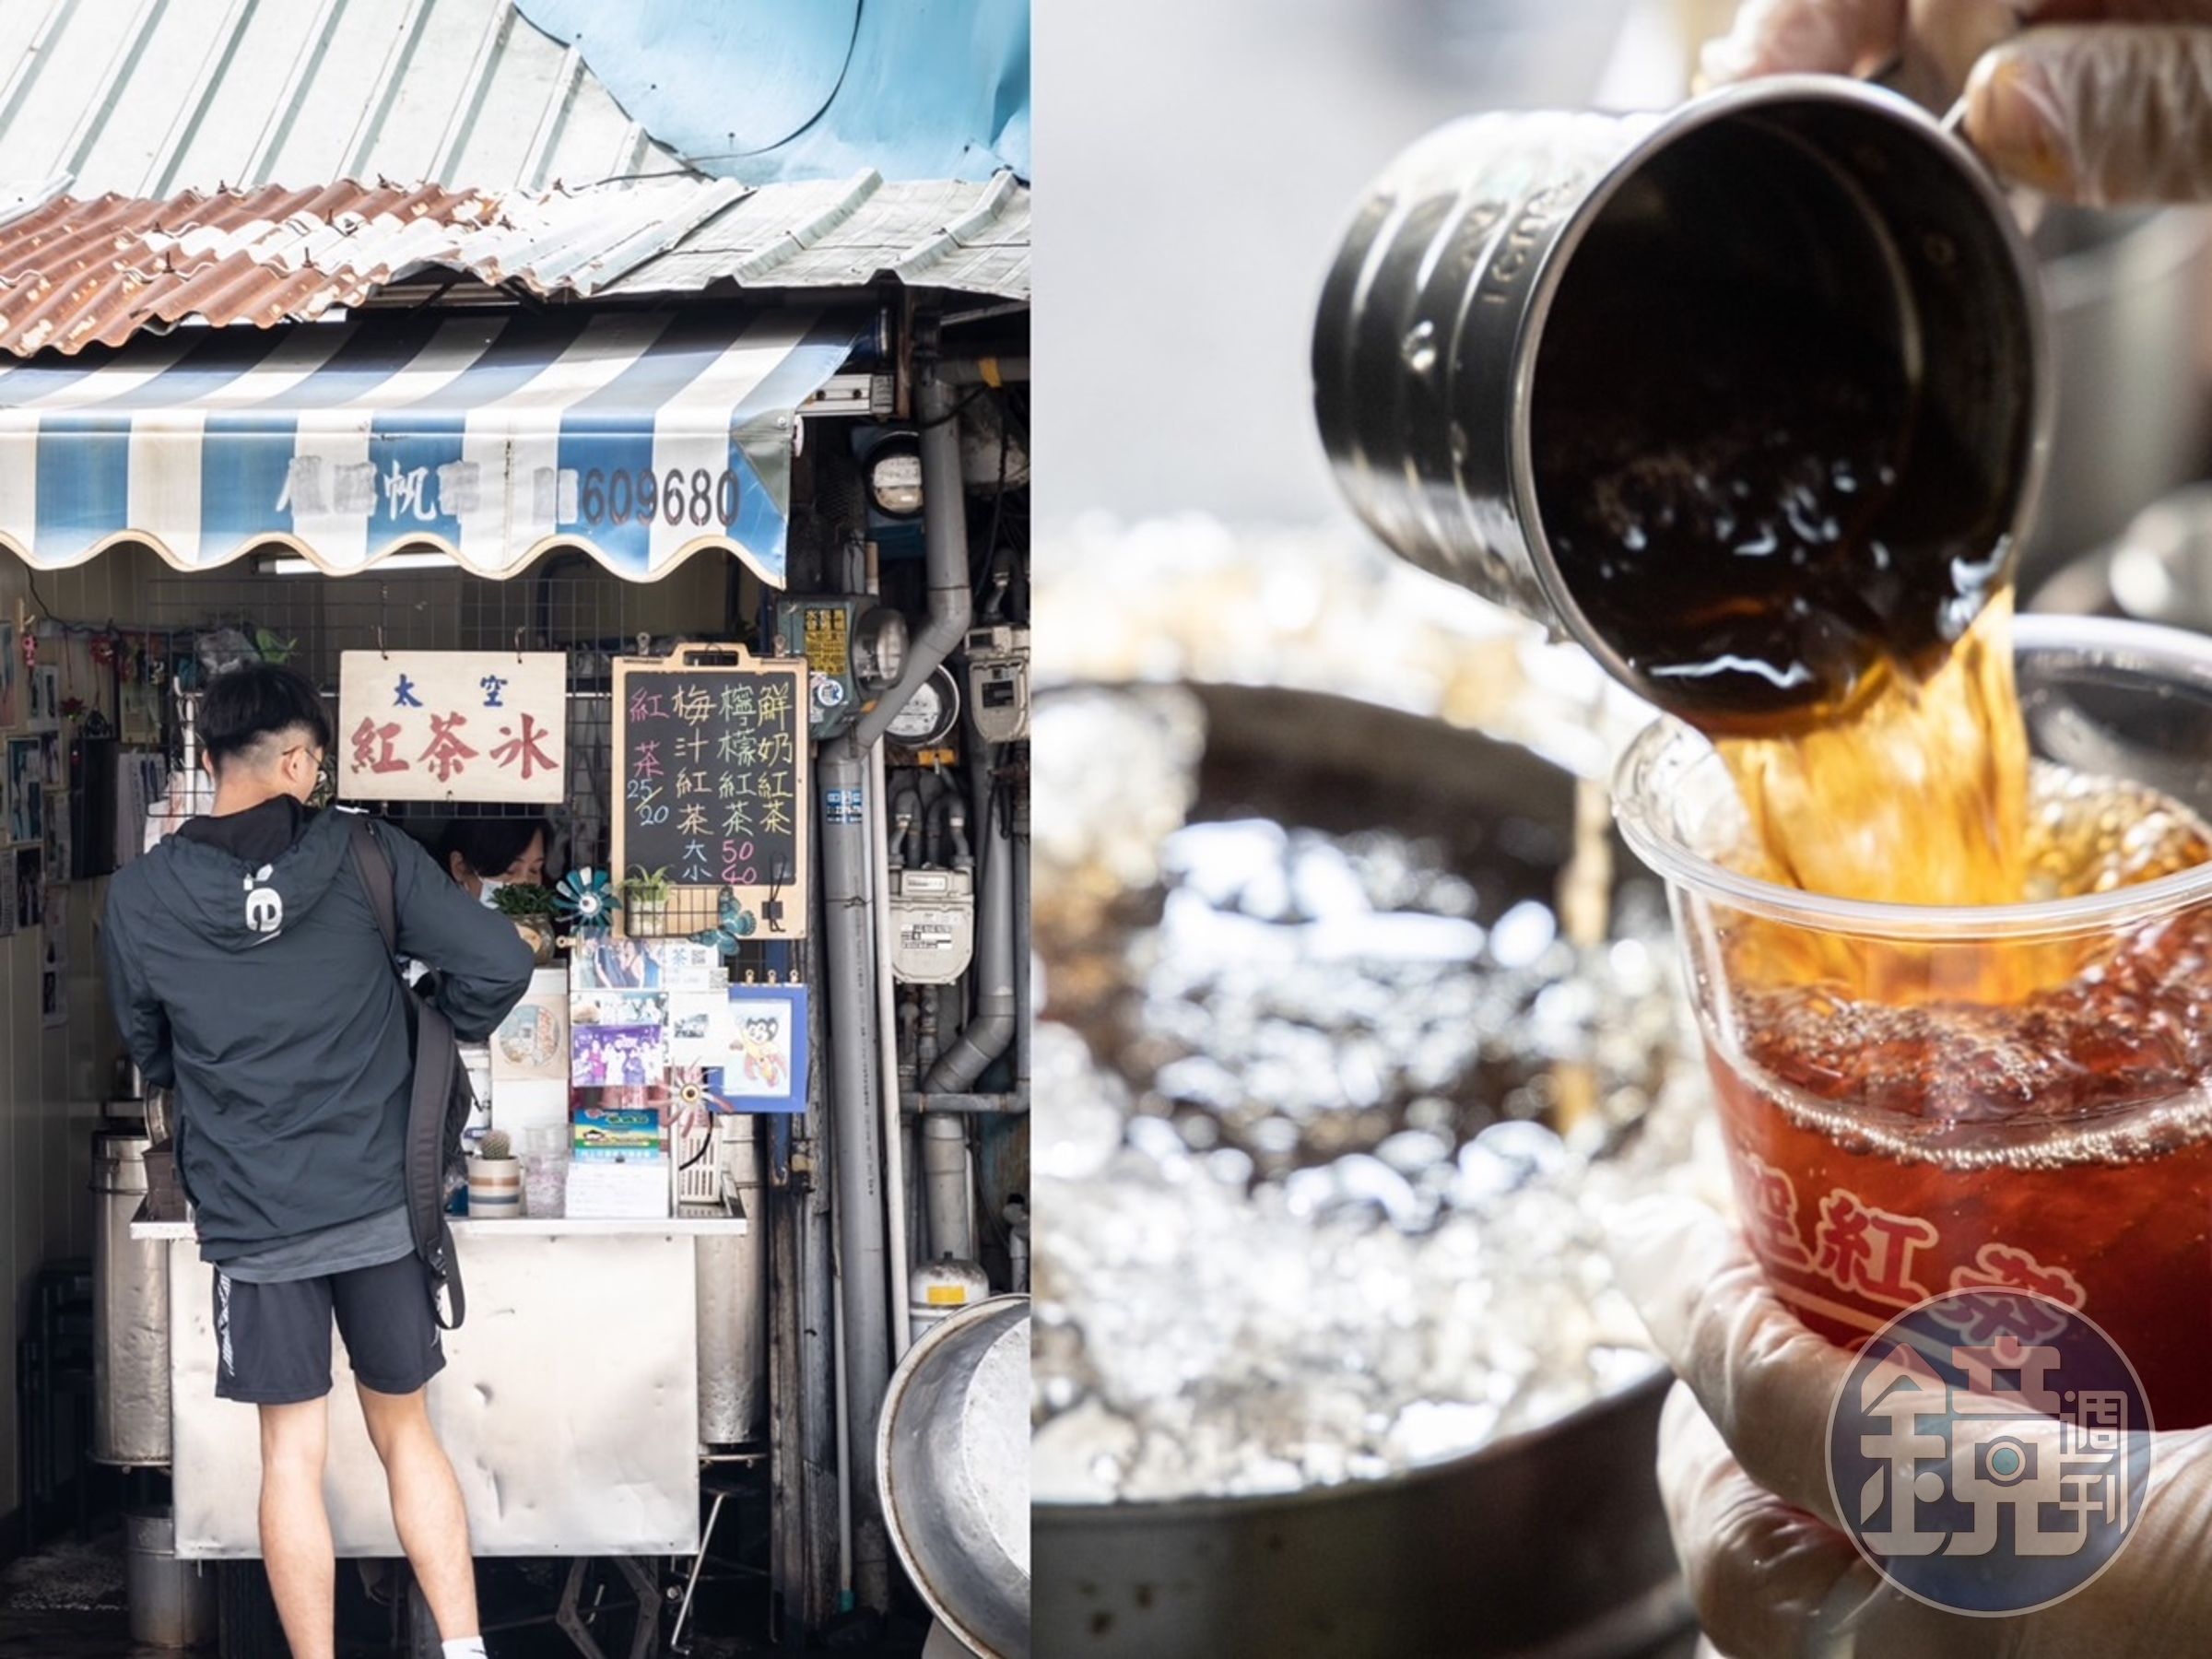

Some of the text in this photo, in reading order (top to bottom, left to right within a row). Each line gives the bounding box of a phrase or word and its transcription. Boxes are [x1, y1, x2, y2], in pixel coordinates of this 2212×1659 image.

[581, 467, 740, 527] 609680
[350, 711, 560, 783] 紅茶冰
[629, 687, 670, 779] 紅茶
[671, 684, 717, 835] 梅汁紅茶
[716, 683, 758, 837] 檸檬紅茶
[757, 681, 794, 835] 鮮奶紅茶
[721, 864, 758, 885] 40
[722, 839, 755, 864] 50
